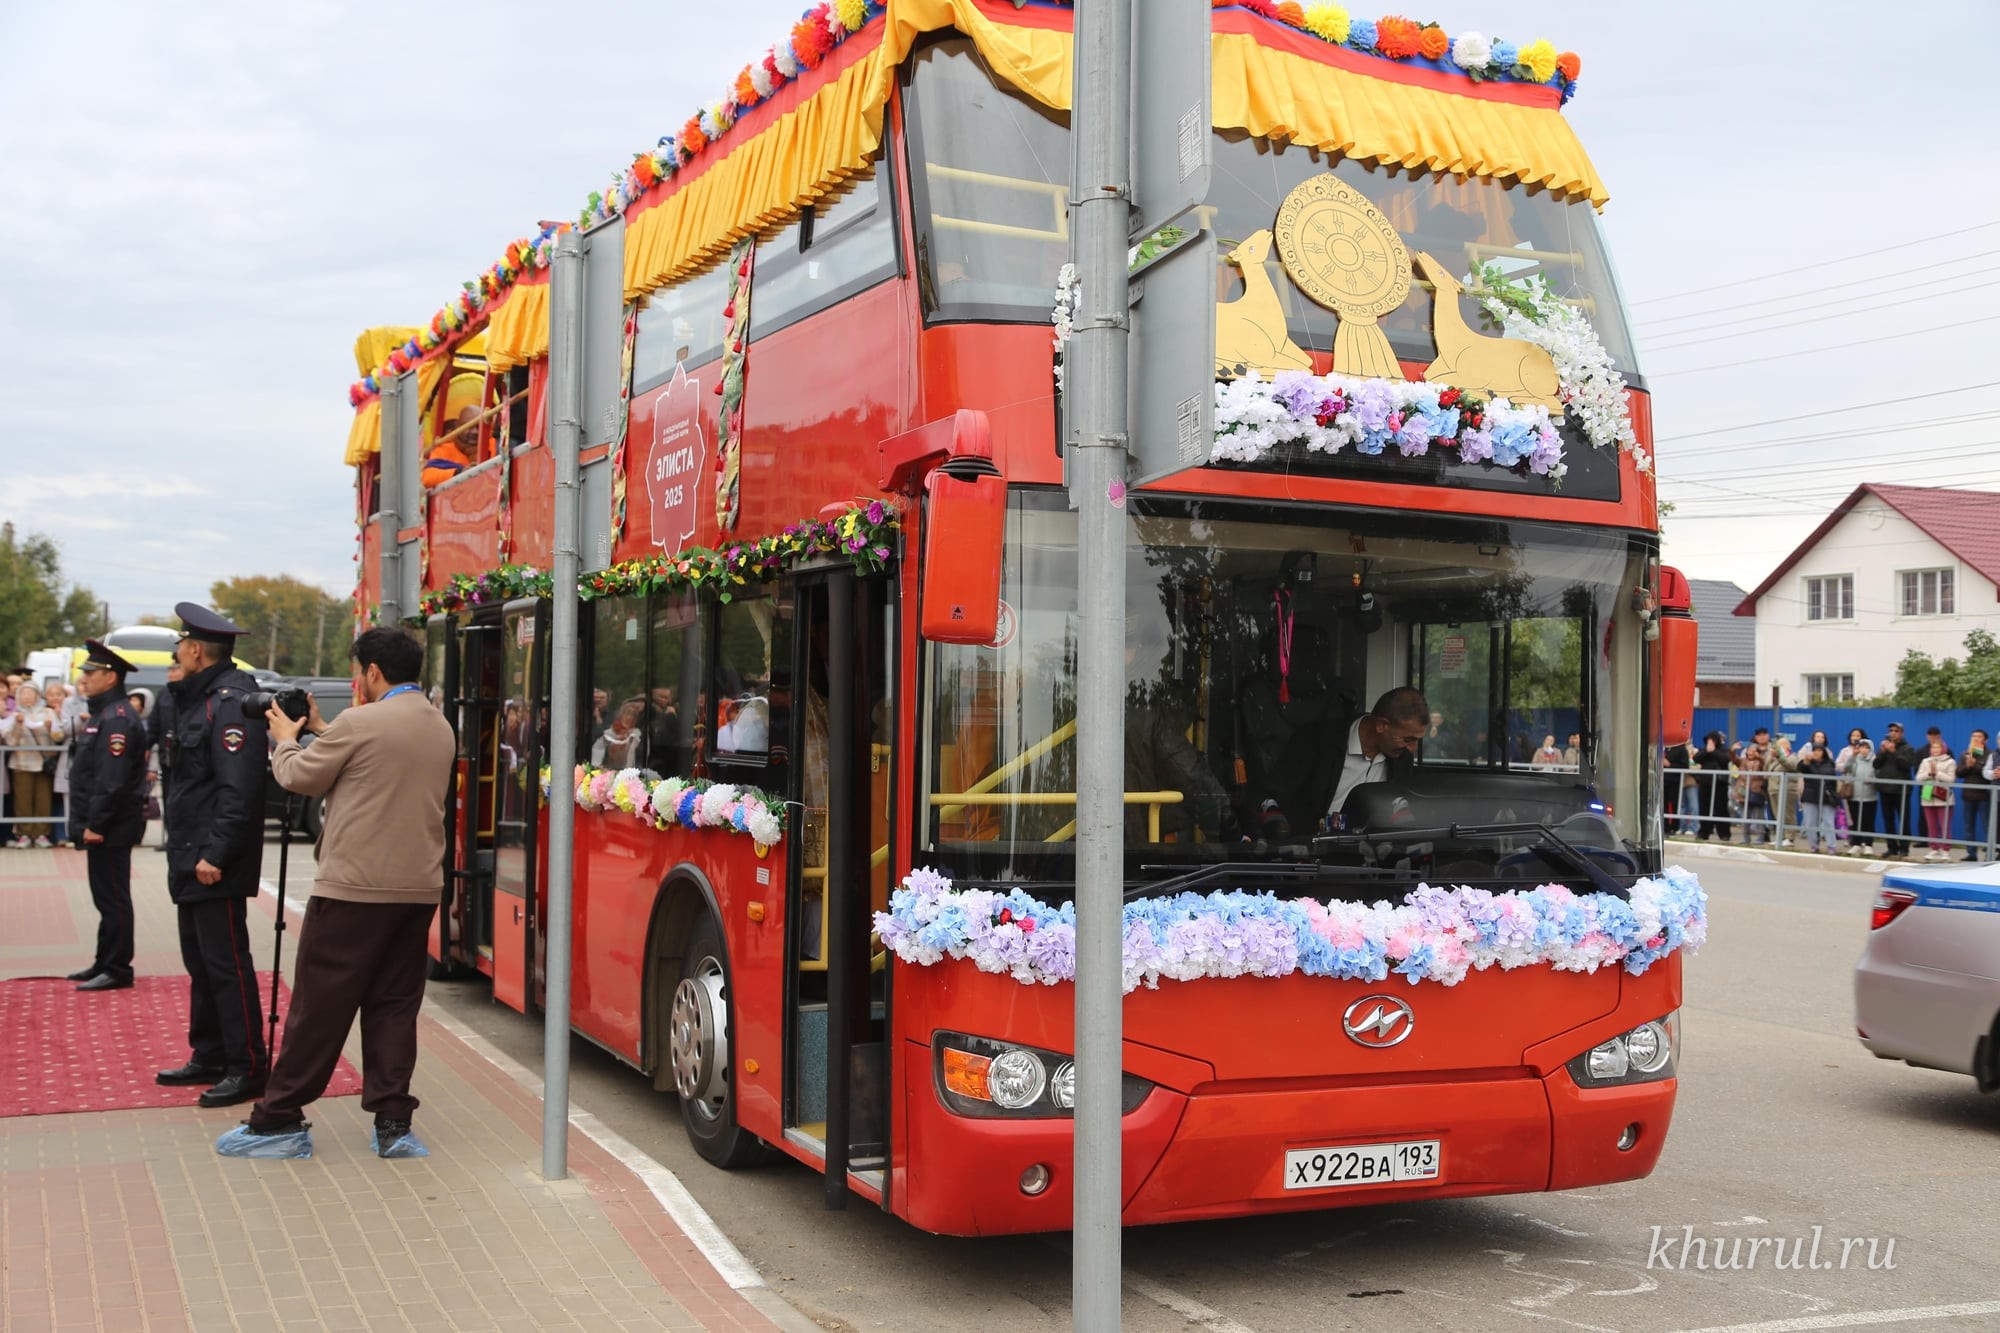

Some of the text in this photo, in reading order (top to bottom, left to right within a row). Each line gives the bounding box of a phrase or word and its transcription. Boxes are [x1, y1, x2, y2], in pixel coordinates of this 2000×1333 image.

[656, 445, 694, 482] ЭЛИСТА
[664, 484, 683, 509] 2025
[1398, 1144, 1434, 1168] 193
[1404, 1166, 1423, 1176] RUS
